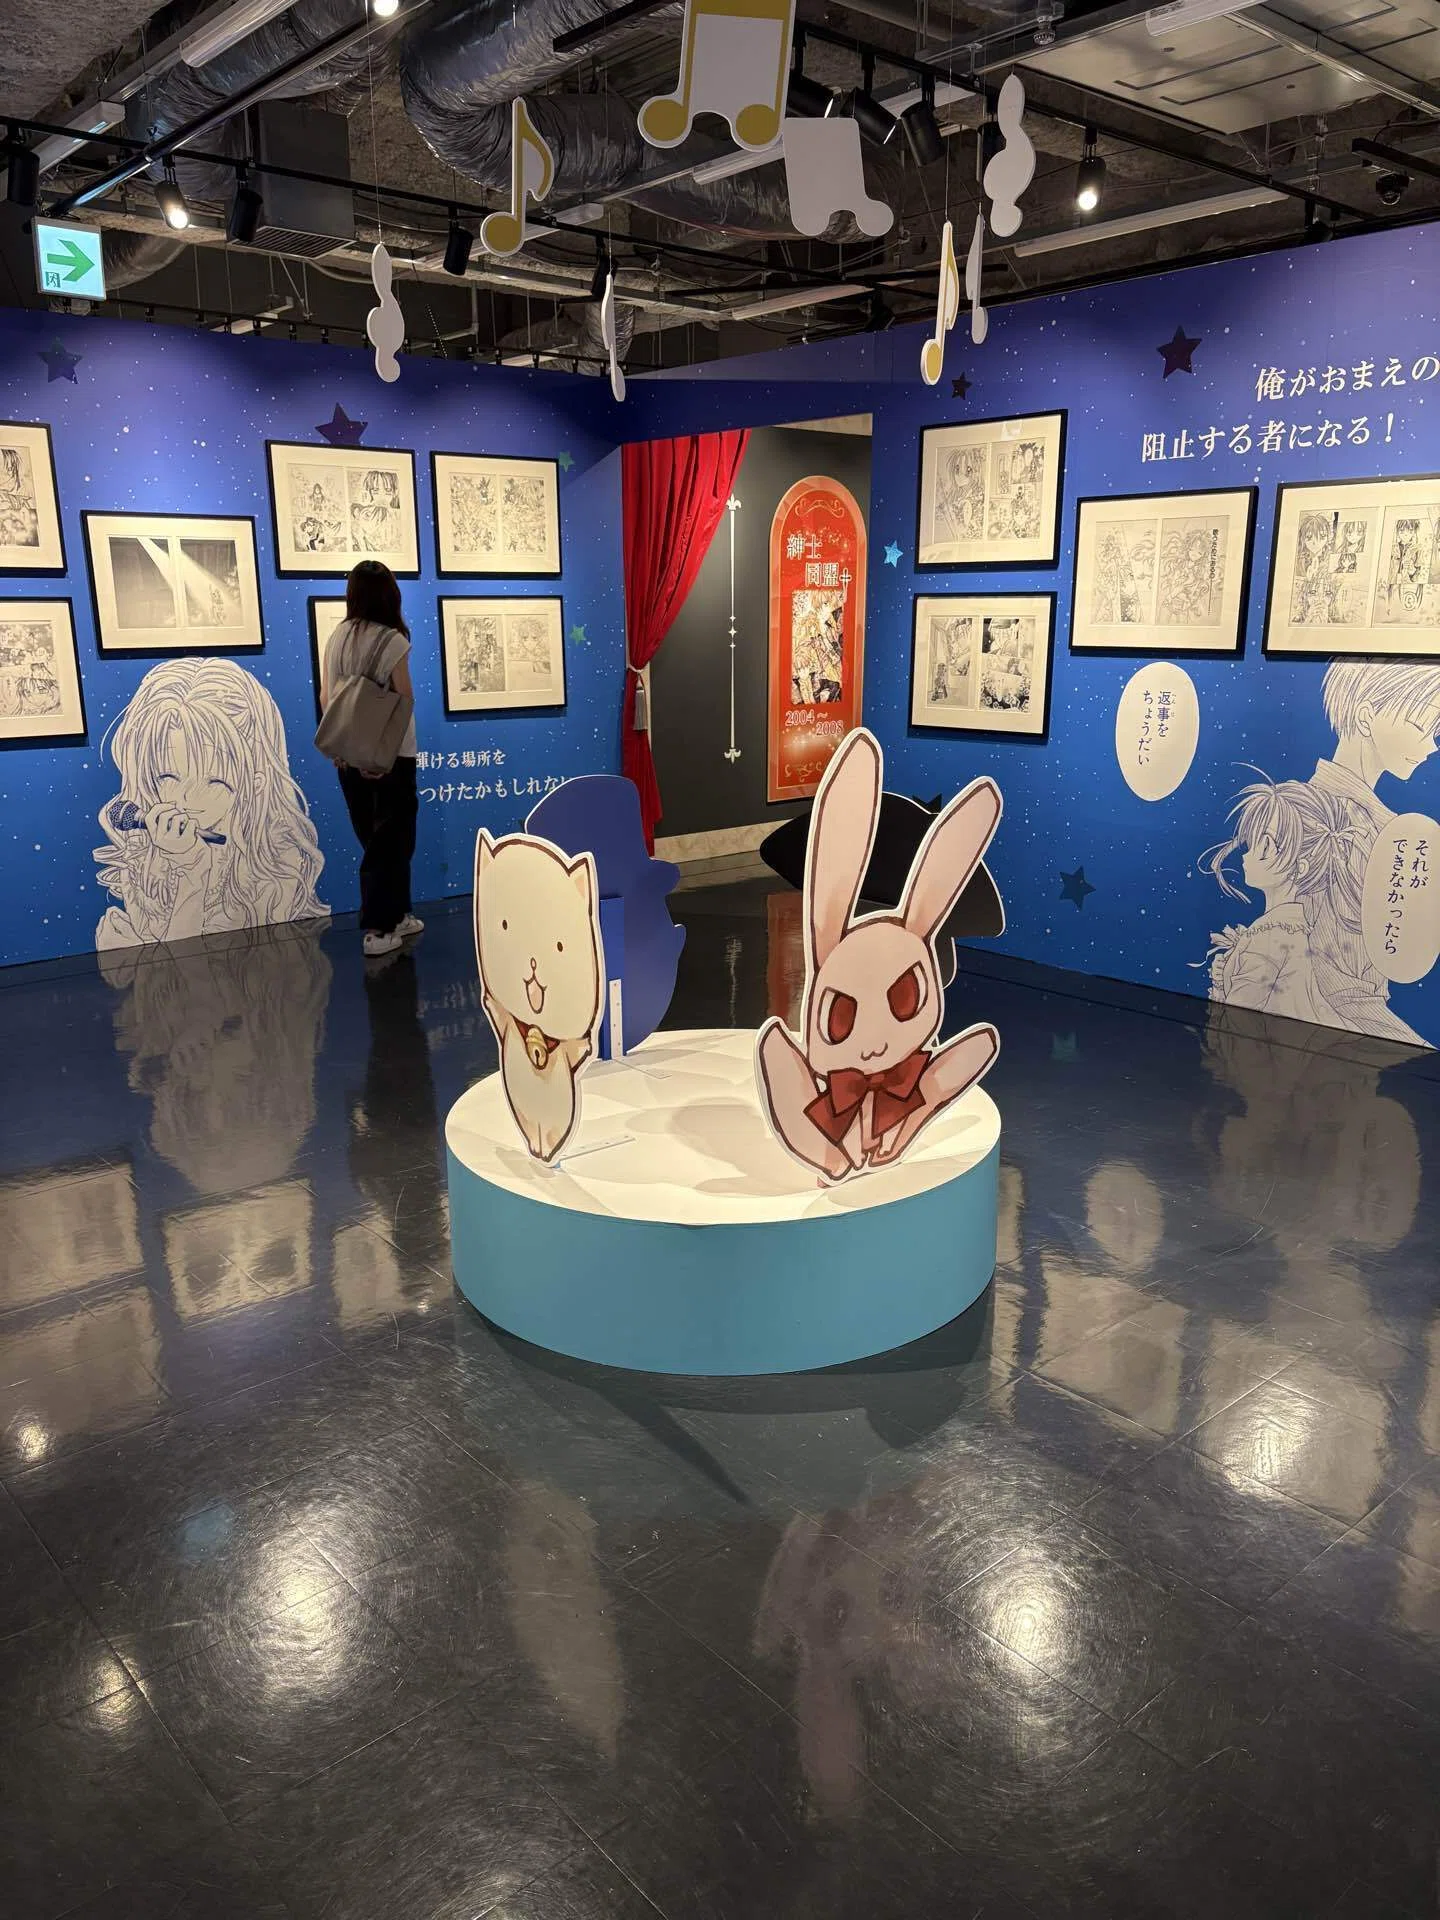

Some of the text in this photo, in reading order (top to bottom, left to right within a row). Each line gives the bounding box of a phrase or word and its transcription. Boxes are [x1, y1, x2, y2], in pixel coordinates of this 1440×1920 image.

[1255, 356, 1440, 402] 俺がおまえの
[1138, 690, 1153, 765] ちょうだい
[1157, 691, 1172, 737] 返事を
[1410, 840, 1429, 889] それが
[1384, 839, 1408, 954] できなかったら
